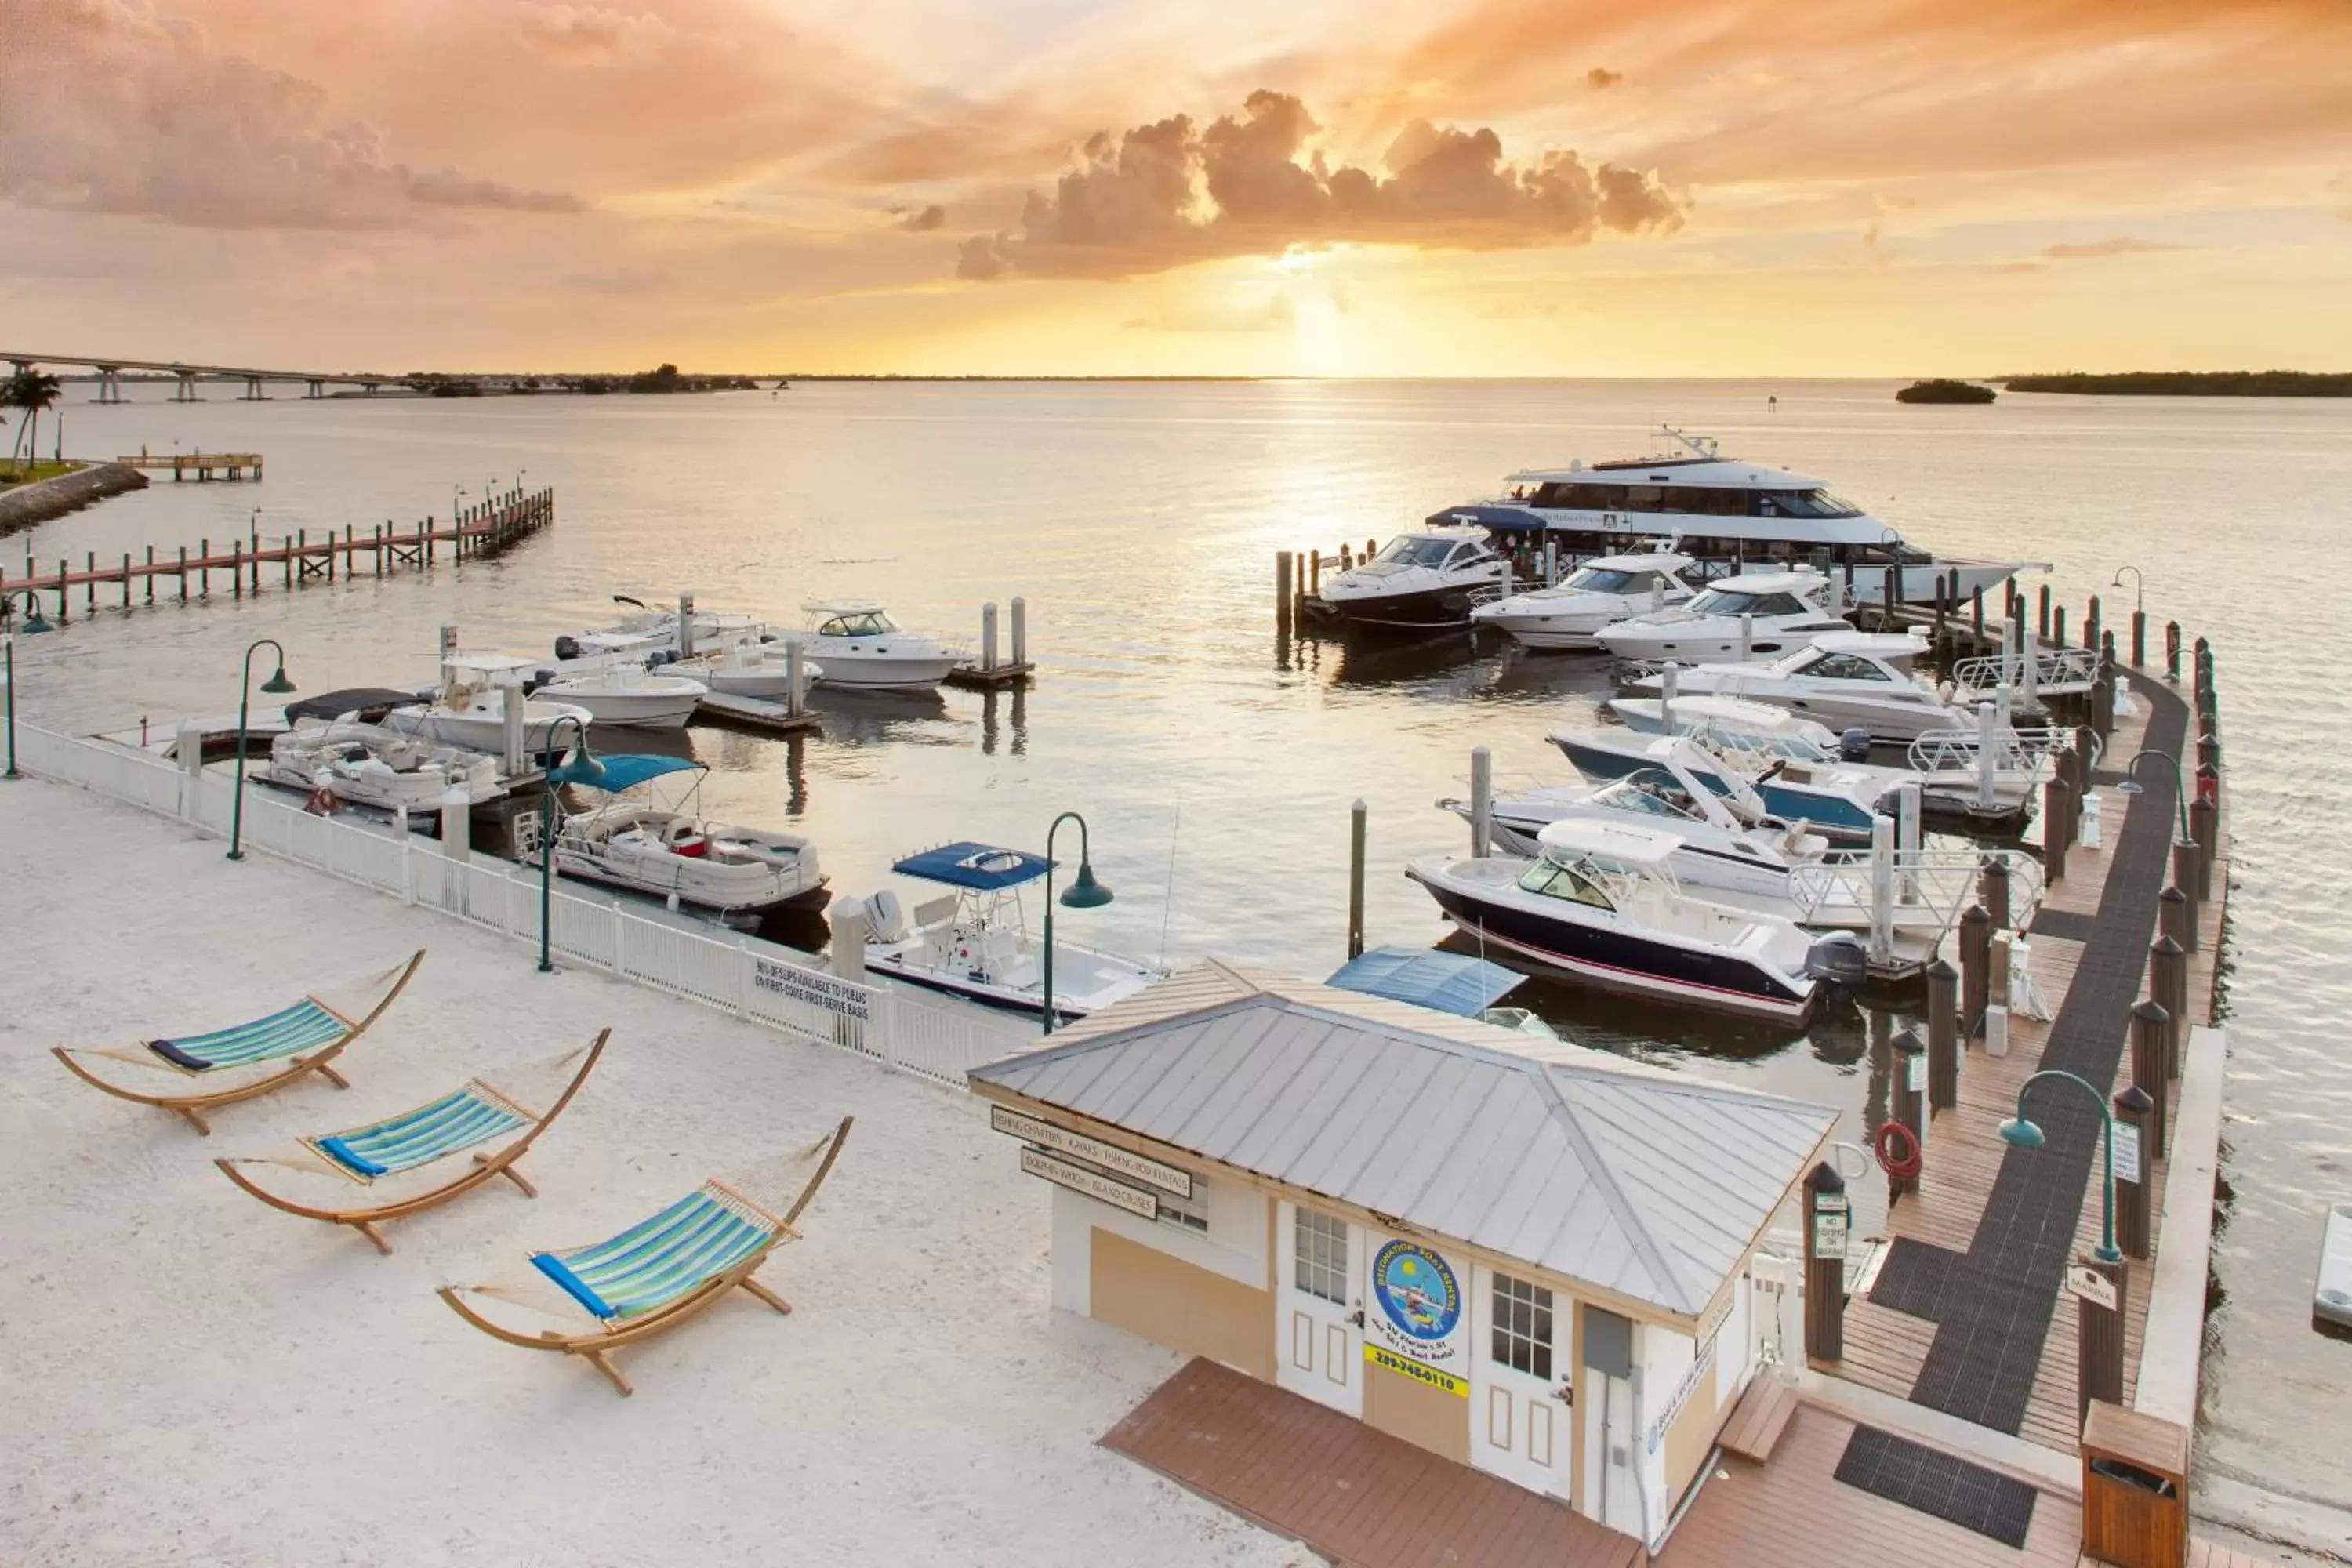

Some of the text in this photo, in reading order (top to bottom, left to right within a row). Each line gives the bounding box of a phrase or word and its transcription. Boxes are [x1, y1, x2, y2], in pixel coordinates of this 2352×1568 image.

[771, 965, 779, 976] OF
[779, 967, 797, 982] SLIPS
[798, 971, 831, 993] AVAILABLE
[832, 983, 840, 996] TO
[841, 985, 866, 1004] PUBLIC
[848, 1003, 869, 1020] BASIS
[995, 1112, 1023, 1131] FISHING
[1024, 1124, 1062, 1144] CHARTERS
[1153, 1168, 1188, 1189] RENTALS
[1025, 1154, 1058, 1175] DOLPHIN
[1091, 1179, 1120, 1198] ISLAND
[1377, 1242, 1456, 1312] DESTINATION BOAT RENTAL
[2071, 1279, 2111, 1301] MARINA
